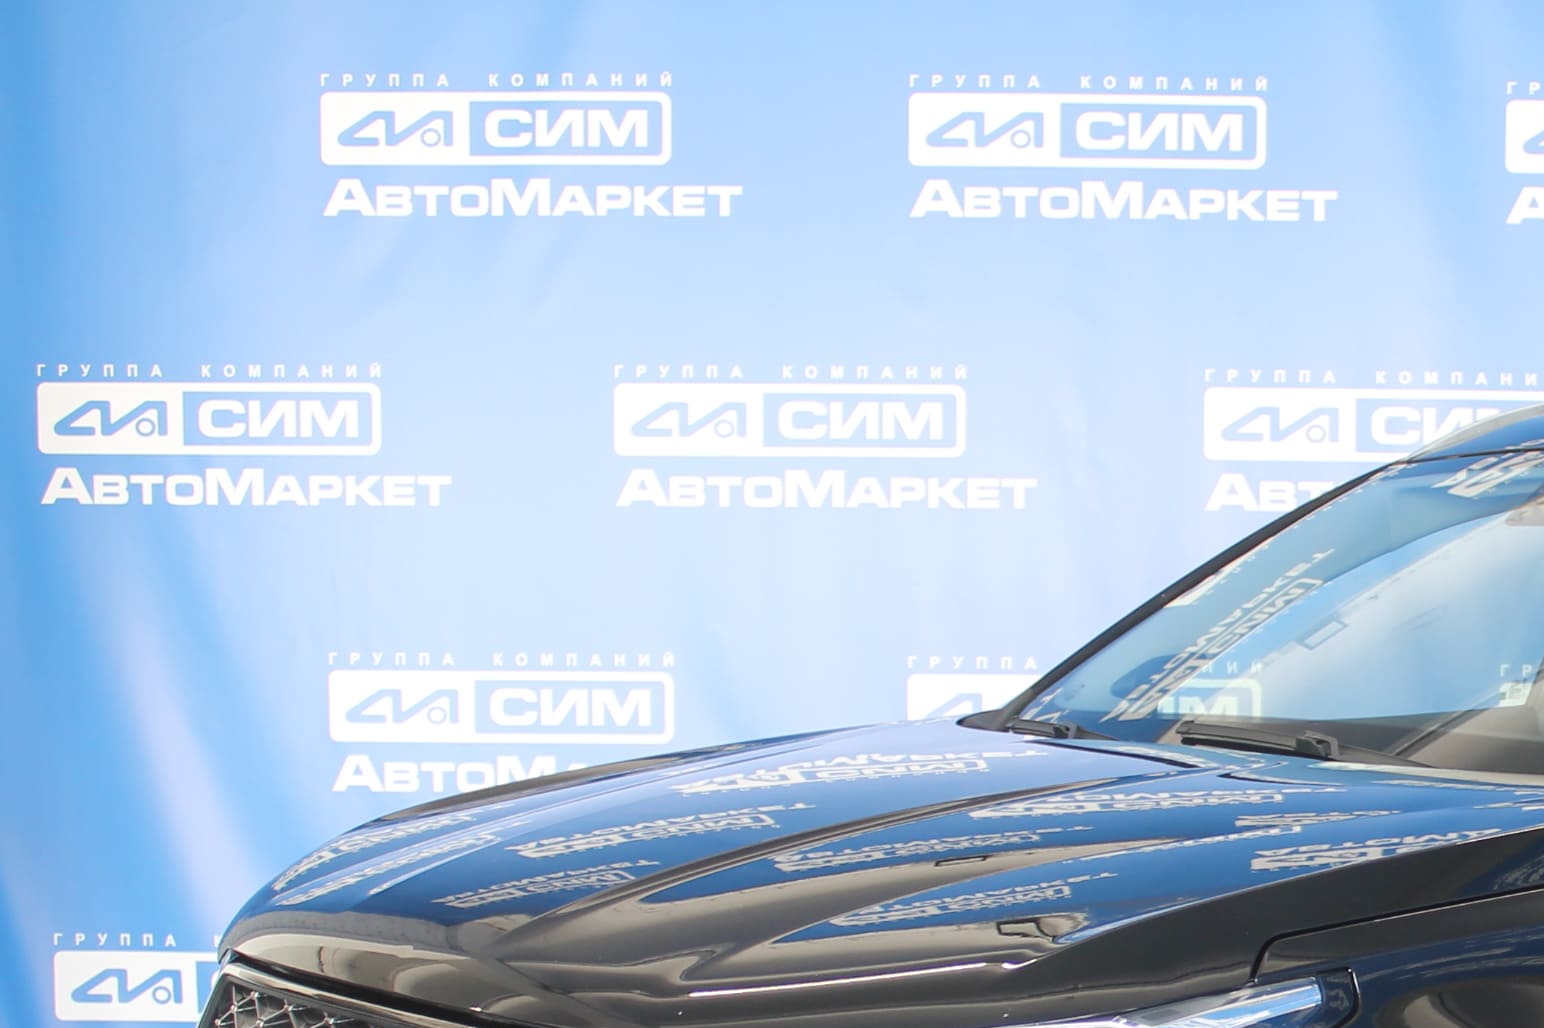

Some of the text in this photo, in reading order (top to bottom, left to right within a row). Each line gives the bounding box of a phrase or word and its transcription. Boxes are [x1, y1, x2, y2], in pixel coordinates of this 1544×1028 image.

[321, 72, 671, 87] ГРУППА КОМПАНИЙ
[910, 74, 1267, 91] ГРУППА КОМПАНИЙ
[485, 109, 648, 148] СИМ
[1076, 111, 1242, 152] СИМ
[38, 362, 381, 378] ГРУППА КОМПАНИЙ
[614, 364, 966, 379] ГРУППА КОМПАНИЙ
[1205, 368, 1335, 383] ГРУППА
[199, 400, 359, 438] СИМ
[778, 401, 942, 440] СИМ
[1371, 406, 1500, 446] СИ
[329, 652, 674, 667] ГРУППА КОМПАНИЙ
[907, 655, 1037, 670] ГРУППА
[489, 688, 650, 727] СИМ
[53, 932, 176, 947] ГРУППА
